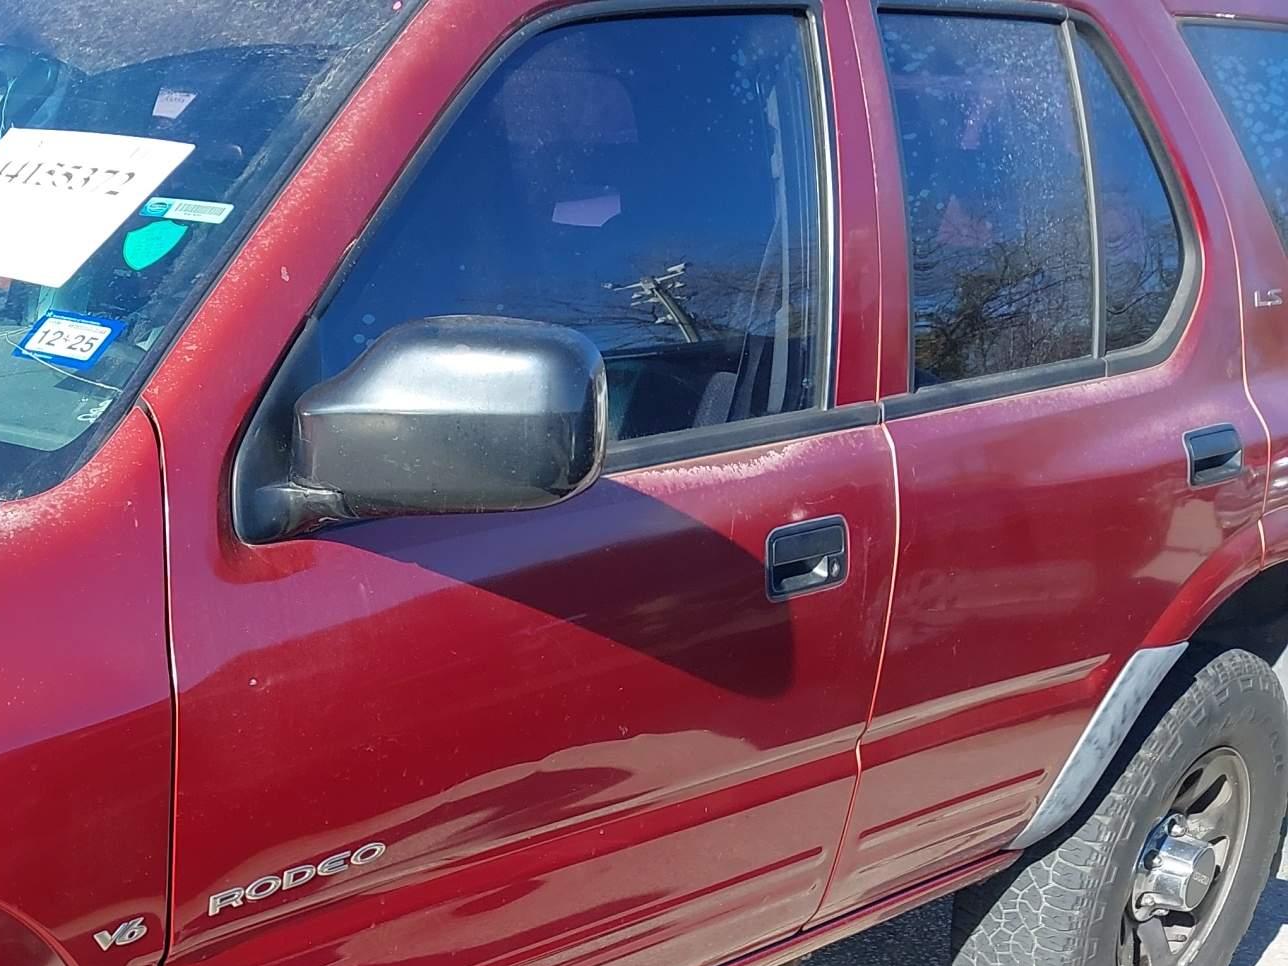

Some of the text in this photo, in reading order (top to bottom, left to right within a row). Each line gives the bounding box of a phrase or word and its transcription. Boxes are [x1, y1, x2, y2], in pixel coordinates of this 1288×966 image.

[1253, 288, 1284, 308] LS
[208, 842, 386, 916] RODEO
[93, 917, 147, 951] V6
